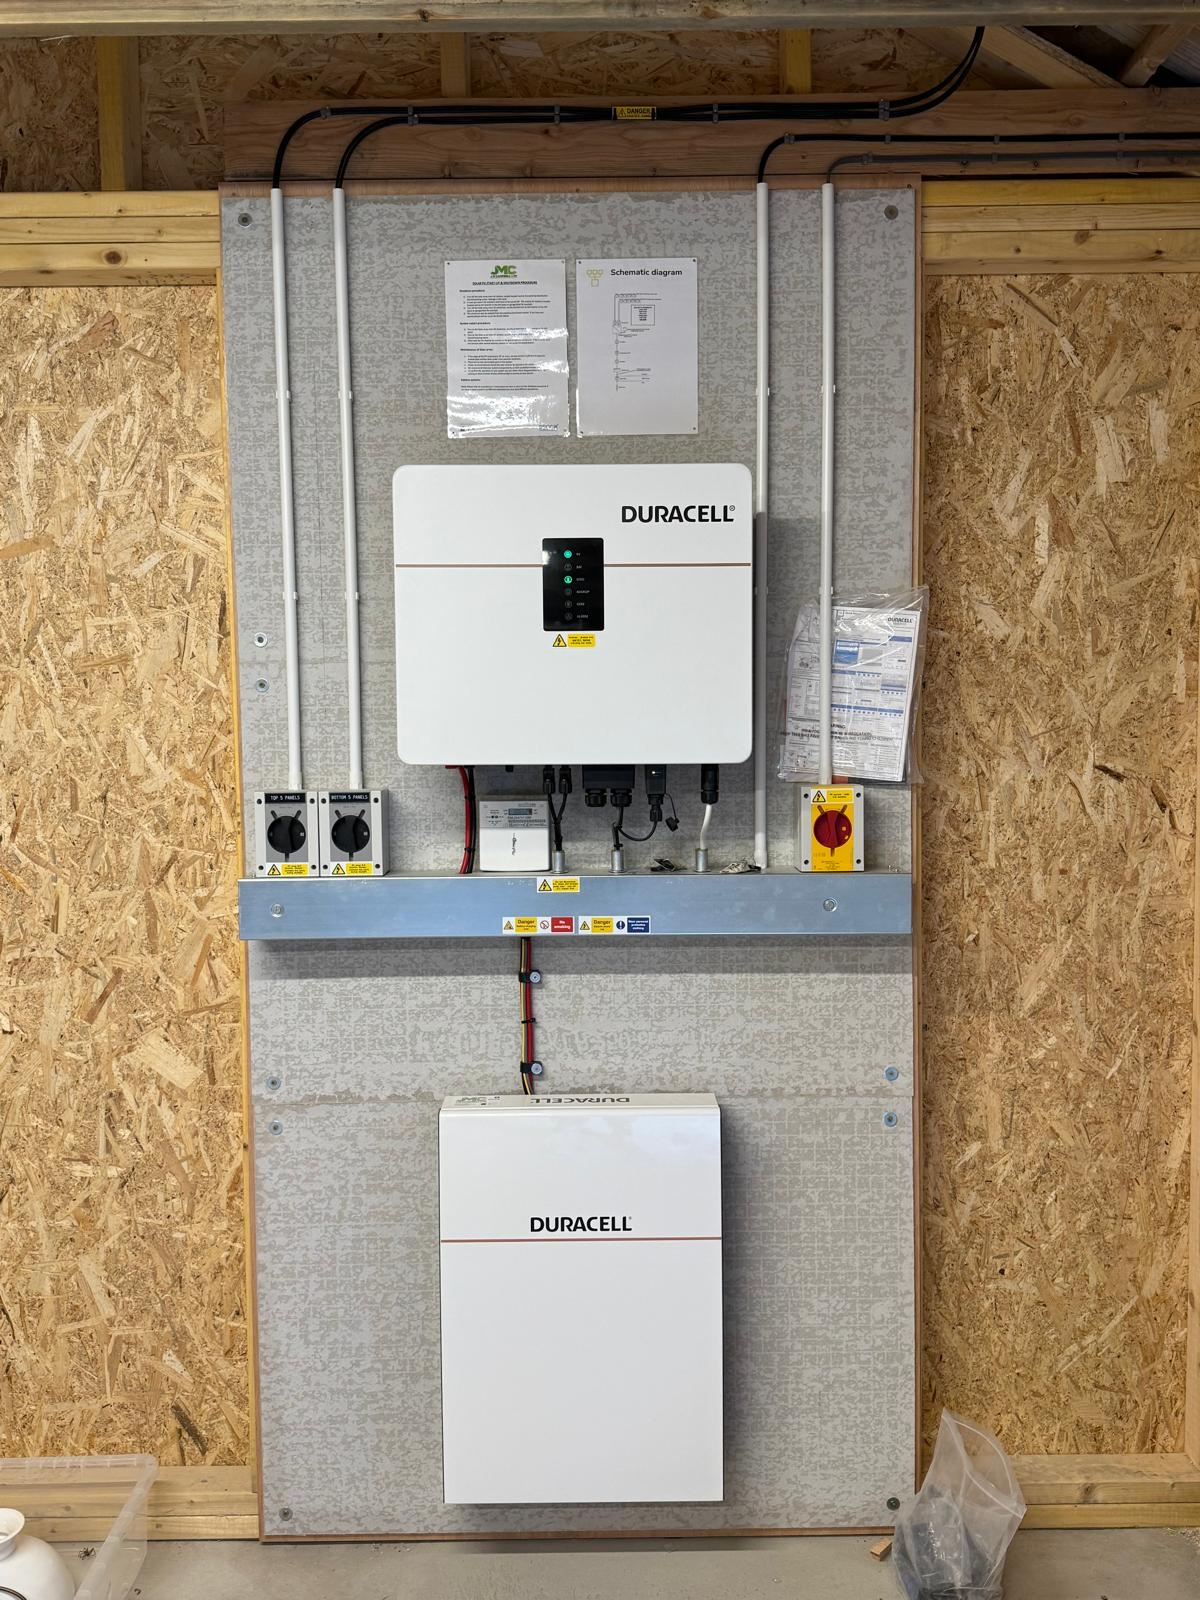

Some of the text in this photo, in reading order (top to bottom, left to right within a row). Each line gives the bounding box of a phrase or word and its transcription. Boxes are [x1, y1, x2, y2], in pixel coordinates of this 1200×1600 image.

[490, 264, 517, 275] JMC
[651, 268, 682, 278] diagram
[530, 1215, 632, 1233] DURACELL
